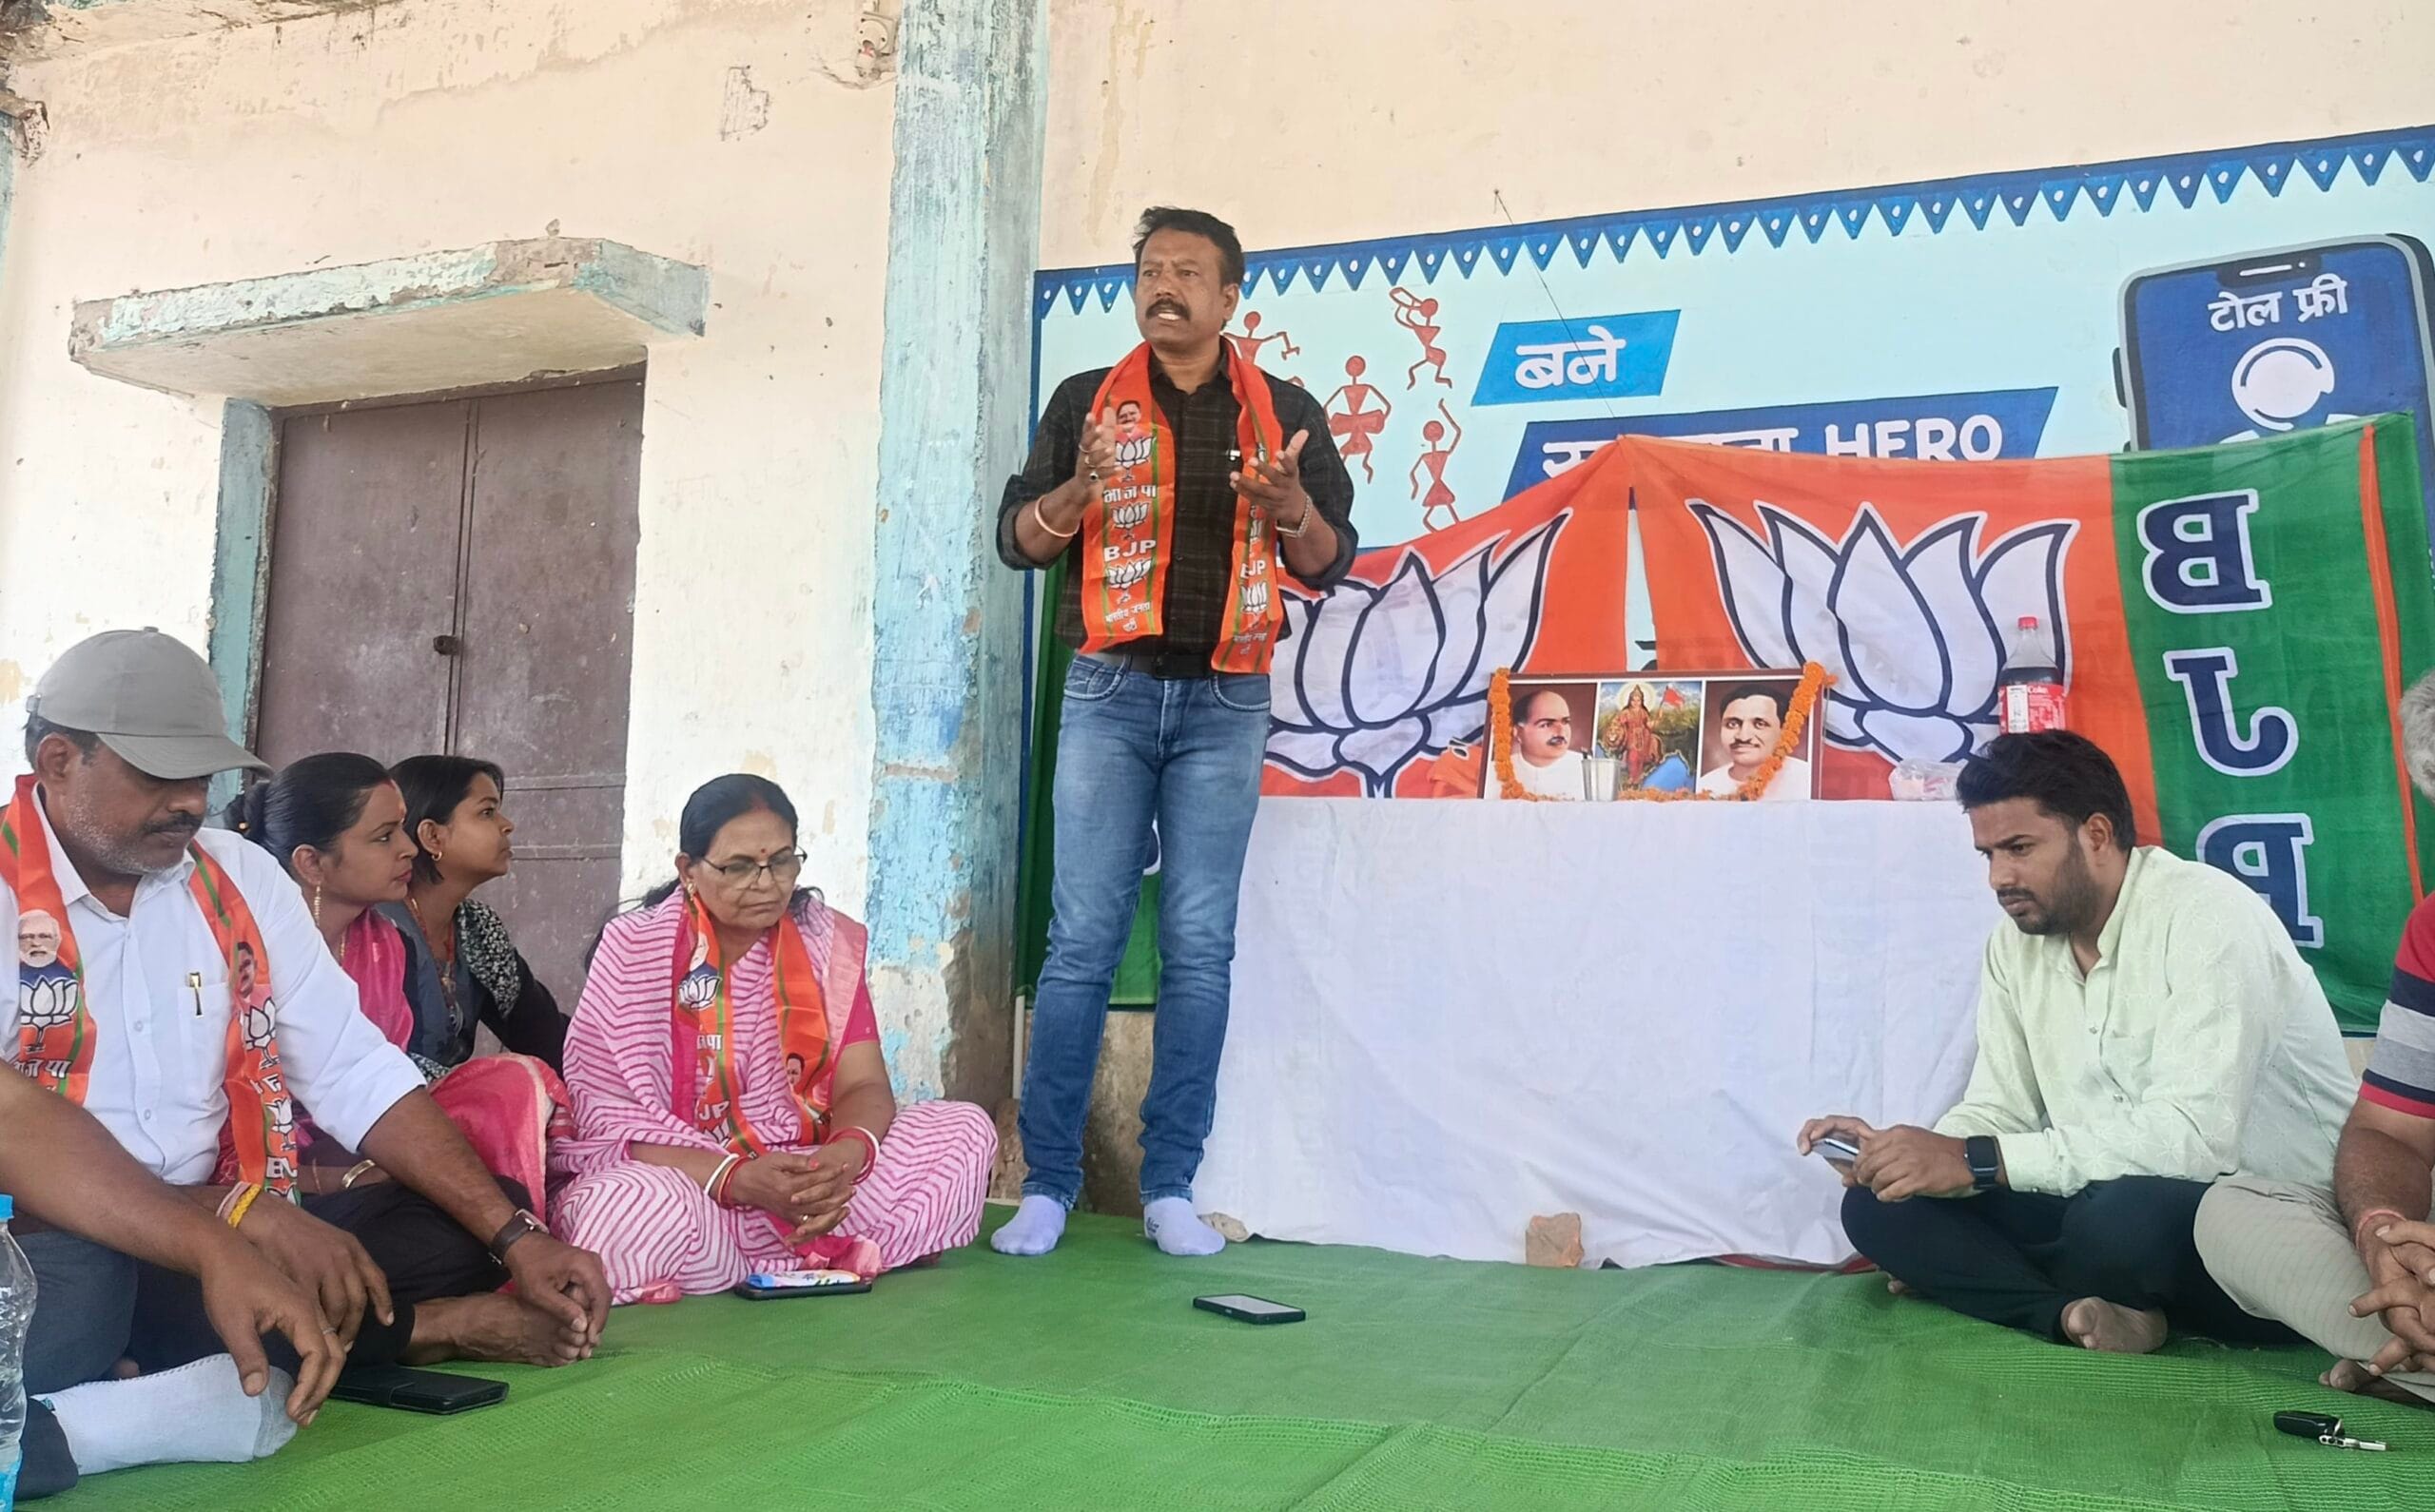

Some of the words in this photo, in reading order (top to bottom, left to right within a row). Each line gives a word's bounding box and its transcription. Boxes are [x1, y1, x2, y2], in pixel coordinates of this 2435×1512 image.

[2208, 291, 2283, 332] टोल
[2291, 272, 2348, 323] फ्री
[1515, 325, 1627, 389] बने
[1824, 414, 2003, 462] HERO
[1103, 539, 1157, 562] BJP
[696, 1099, 730, 1121] JP
